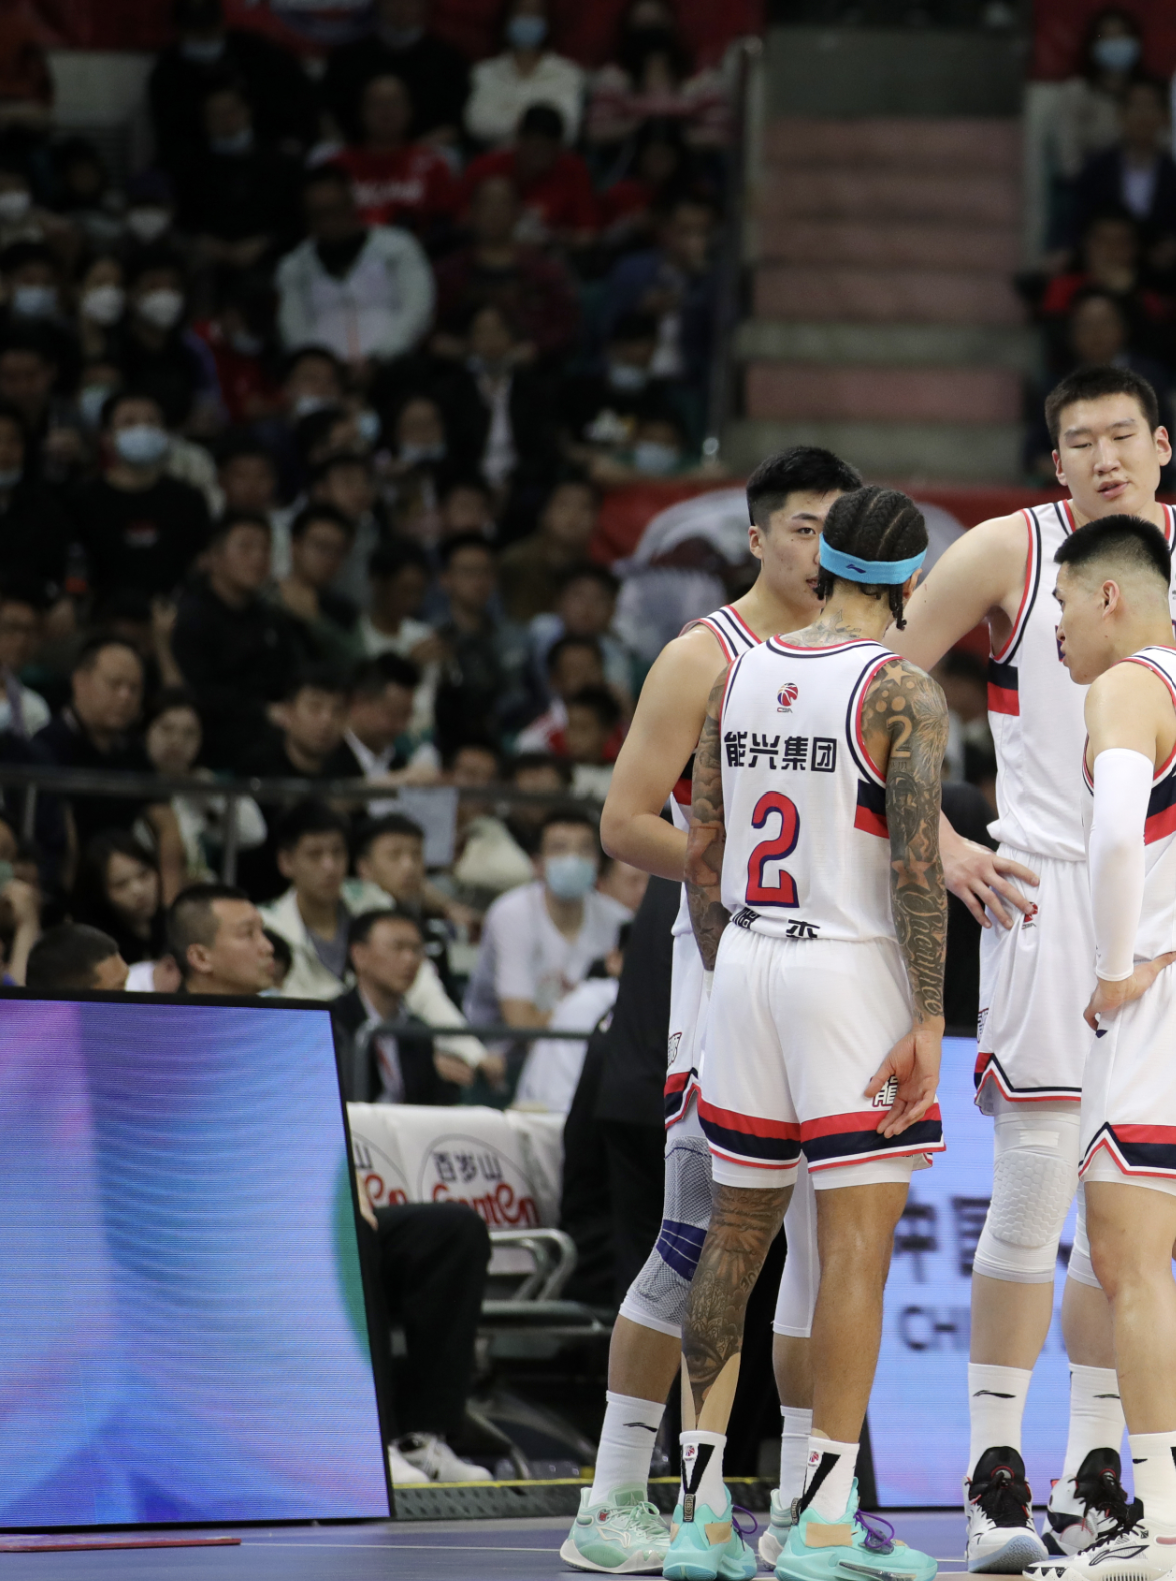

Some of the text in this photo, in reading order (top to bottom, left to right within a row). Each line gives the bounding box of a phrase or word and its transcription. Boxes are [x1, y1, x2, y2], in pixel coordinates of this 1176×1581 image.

[724, 731, 837, 773] 能兴集团
[745, 791, 800, 908] 2
